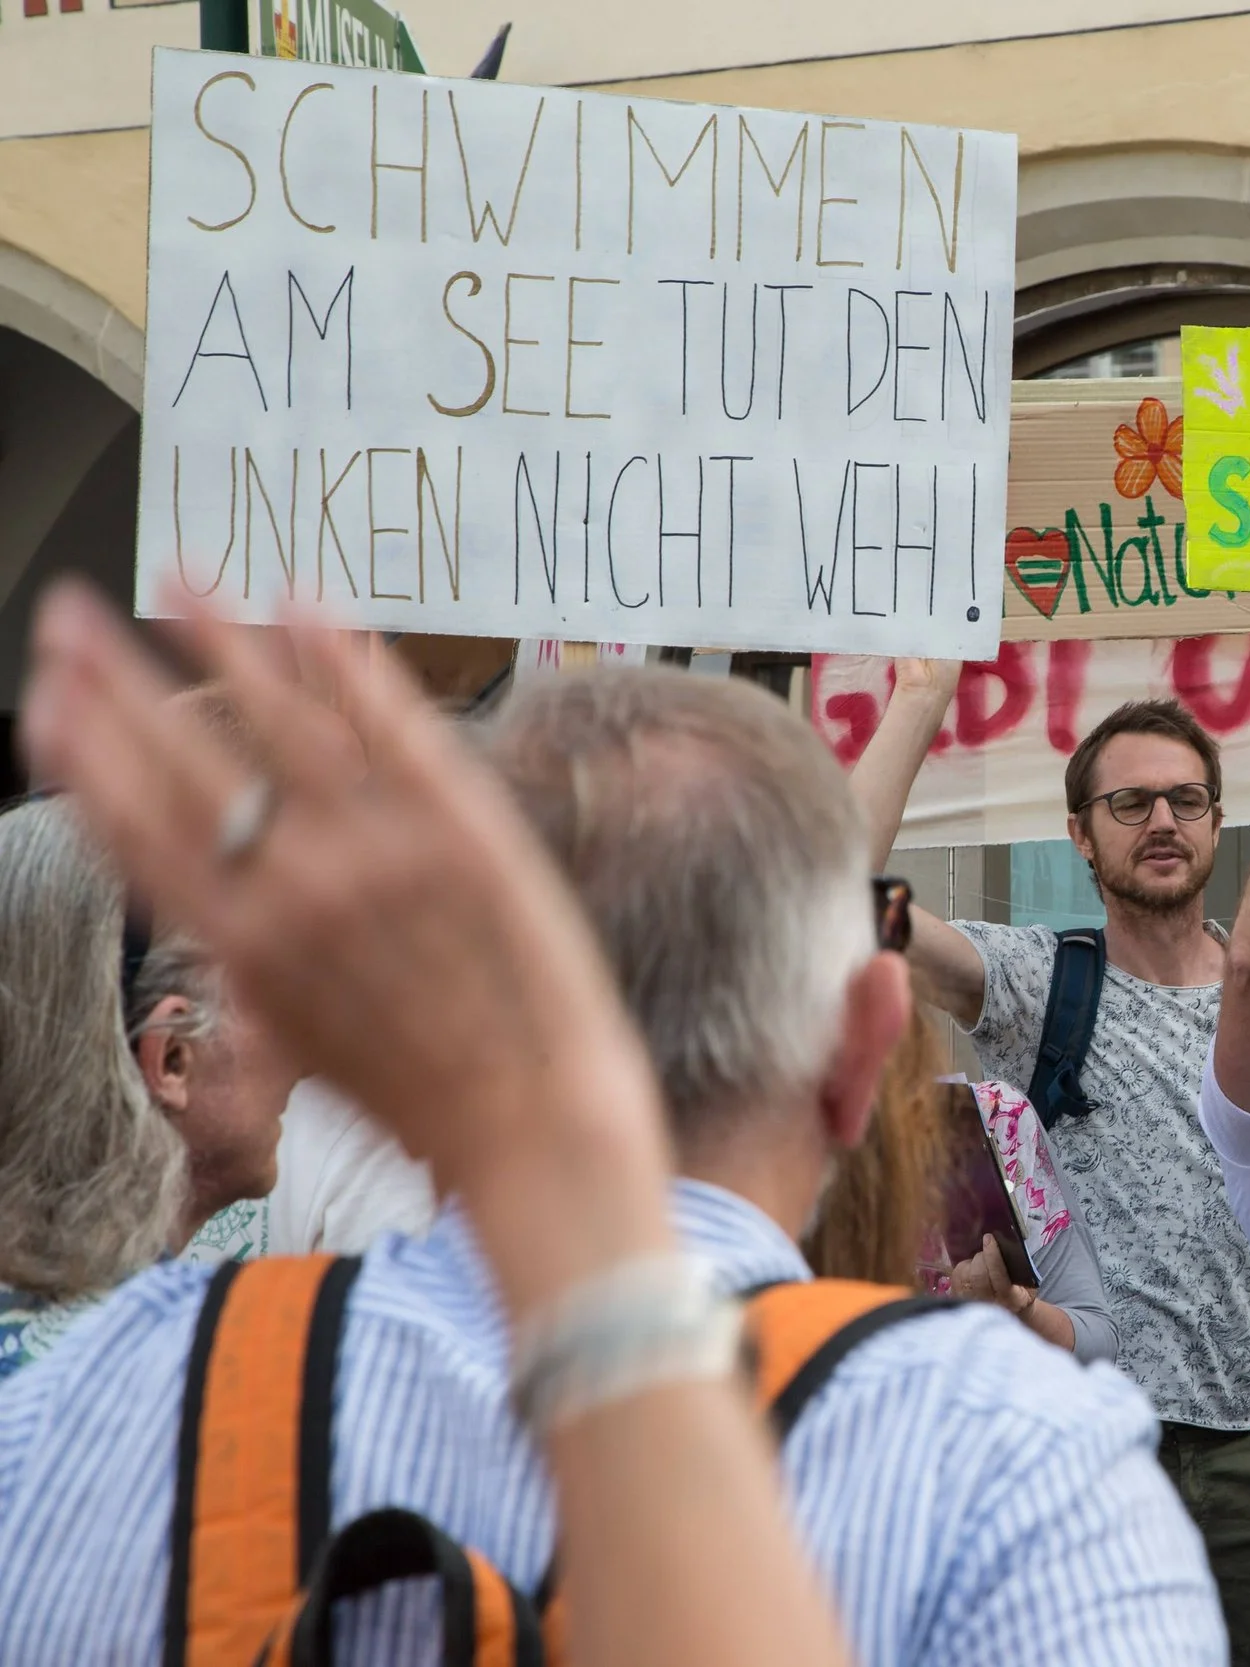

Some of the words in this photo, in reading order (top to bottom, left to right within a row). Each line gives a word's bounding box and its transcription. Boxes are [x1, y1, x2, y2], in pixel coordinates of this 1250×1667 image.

[187, 70, 964, 274] SCHWIMMEN
[172, 265, 354, 412] AM
[427, 270, 620, 419] SEE
[658, 279, 813, 420] TUT
[846, 287, 989, 424] DEN
[173, 445, 463, 604] UNKEN
[514, 450, 753, 608] NICHT
[793, 456, 980, 622] WEH!
[1064, 495, 1236, 614] Natu
